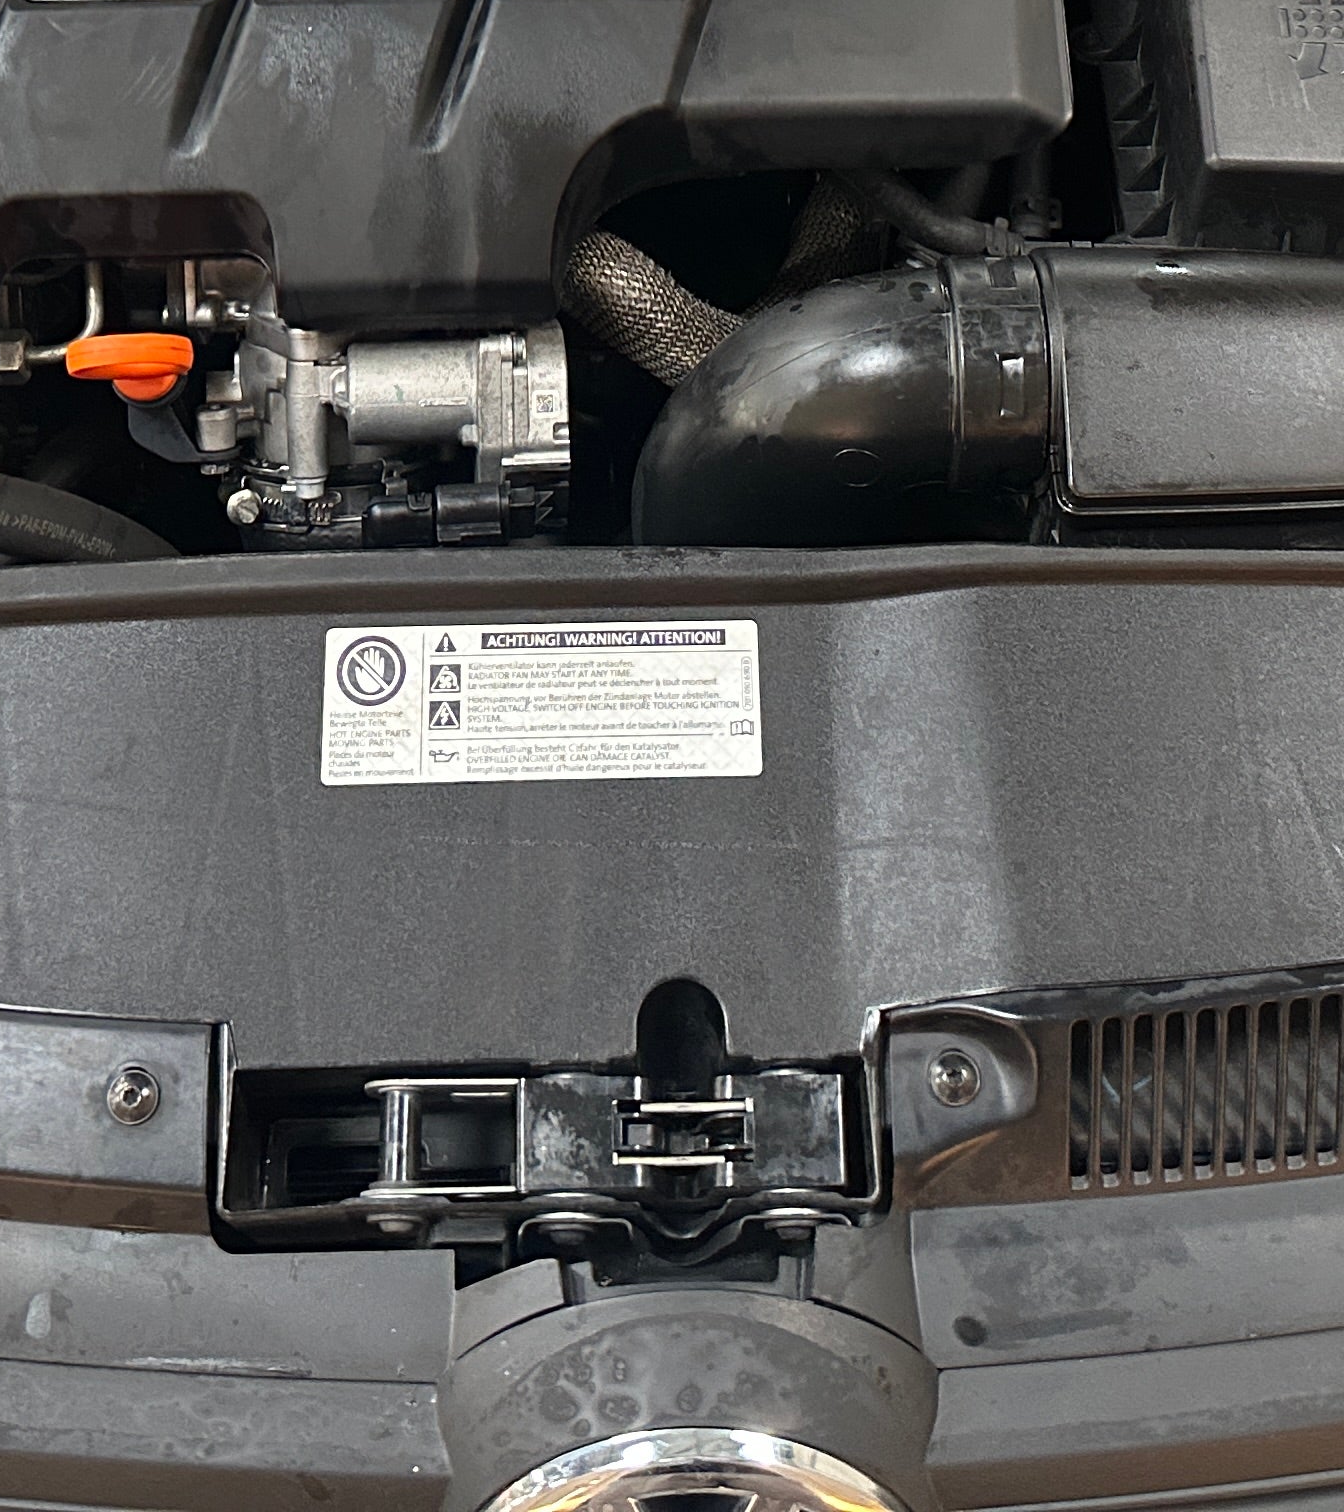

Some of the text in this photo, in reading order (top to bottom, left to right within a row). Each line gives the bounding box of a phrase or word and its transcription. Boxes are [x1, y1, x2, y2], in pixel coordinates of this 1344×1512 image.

[486, 630, 721, 647] ACHTUNG! WARNING! ATTENTION!
[537, 661, 557, 669] kann
[468, 671, 510, 680] RADIATOR
[512, 671, 528, 679] FAN
[552, 670, 576, 678] START
[578, 669, 589, 677] AT
[590, 669, 609, 677] ANY
[526, 680, 535, 688] de
[577, 680, 598, 690] peut
[663, 678, 680, 686] tout
[588, 694, 602, 702] der
[468, 705, 490, 713] HIGH
[533, 704, 566, 712] SWITCH
[585, 703, 617, 711] ENGINE
[620, 702, 651, 710] BEFORE
[653, 701, 698, 710] TOUCHING
[701, 701, 740, 709] IGNITION
[468, 725, 493, 733] Haute
[560, 723, 567, 731] le
[569, 723, 599, 731] moteur
[626, 722, 636, 730] de
[638, 721, 670, 729] toucher
[330, 729, 411, 738] HOT ENGINE PARTS
[329, 739, 366, 747] MOVING
[534, 744, 566, 753] besteht
[615, 743, 630, 751] den
[354, 750, 364, 758] du
[467, 755, 516, 764] OVERFILLED
[518, 754, 550, 762] ENGINE
[553, 753, 566, 762] OIL
[570, 753, 588, 761] CAN
[591, 752, 628, 761] DAMAGE
[633, 763, 652, 772] pour
[654, 761, 661, 769] le
